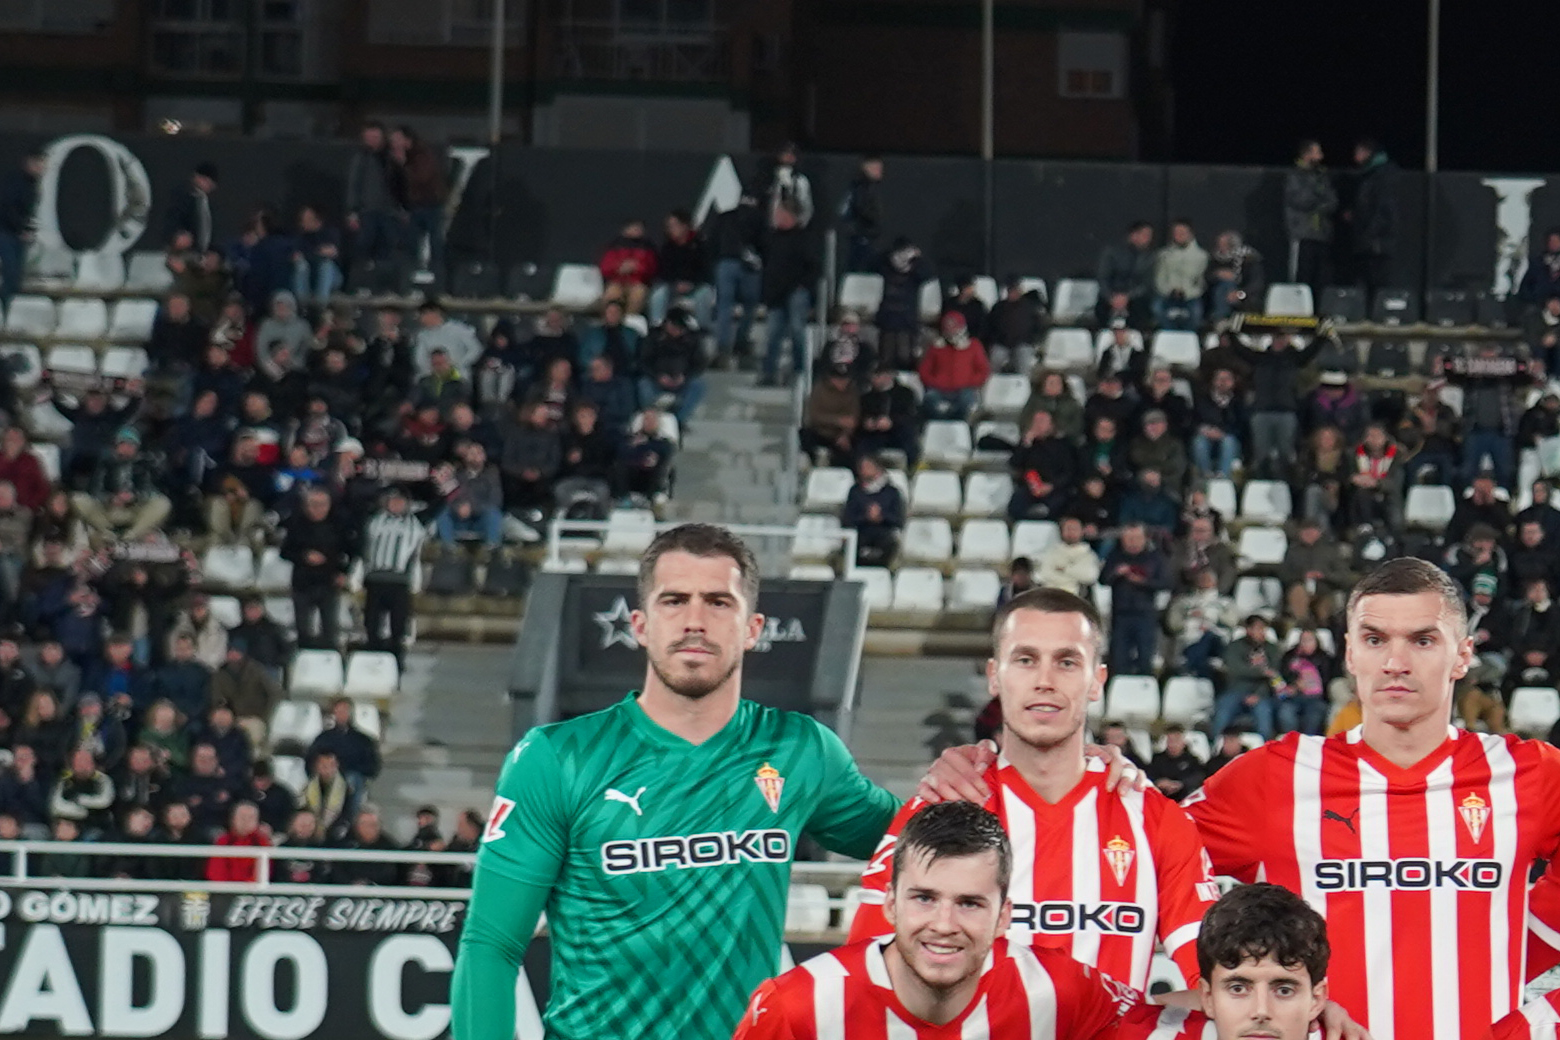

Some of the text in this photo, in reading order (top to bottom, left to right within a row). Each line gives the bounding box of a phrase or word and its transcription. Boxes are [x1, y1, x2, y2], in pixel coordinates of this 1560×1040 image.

[603, 830, 790, 873] SIROKO
[1315, 860, 1502, 889] SIROKO
[19, 889, 159, 925] GÓMEZ
[326, 899, 465, 932] SIEMPRE
